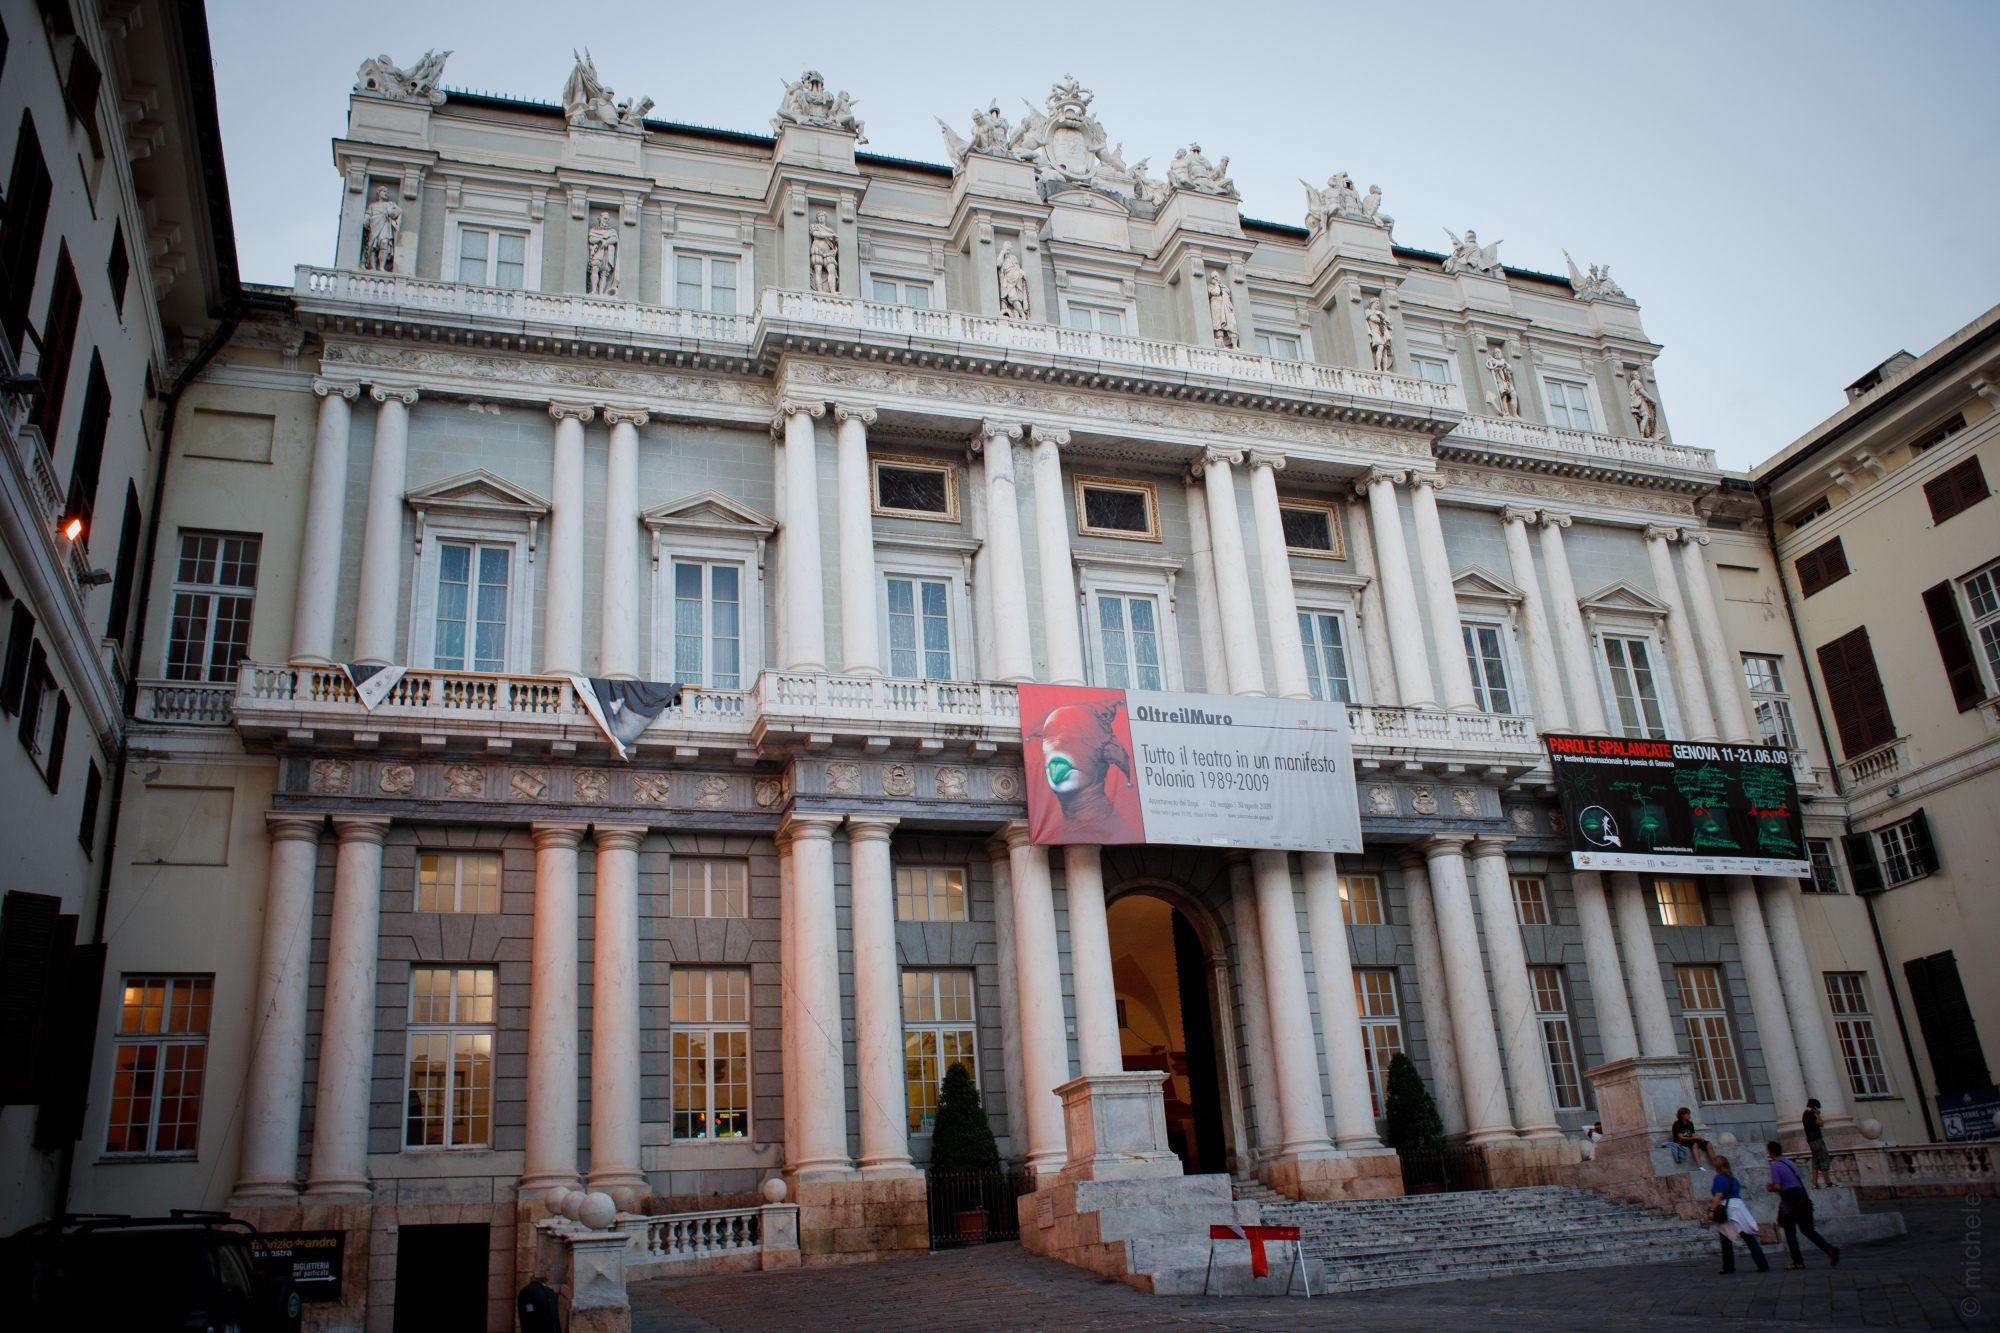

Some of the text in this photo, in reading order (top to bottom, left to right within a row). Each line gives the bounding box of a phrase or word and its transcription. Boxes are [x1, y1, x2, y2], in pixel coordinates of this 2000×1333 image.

[1137, 705, 1233, 726] OltreilMuro
[1141, 744, 1336, 774] Tutto il teatro in un manifesto
[1549, 737, 1789, 765] PAROLE SPALANCATE GENOVA 11-21.06.09
[1563, 755, 1585, 764] festival
[1585, 756, 1624, 767] internazionale
[1624, 758, 1630, 766] di
[1630, 760, 1648, 768] poesia
[1648, 759, 1655, 767] di
[1655, 760, 1675, 768] Genova
[1145, 767, 1270, 792] Polonia 1989-2009
[1217, 801, 1234, 810] maggio
[293, 1261, 330, 1271] BIGLIETTERIA
